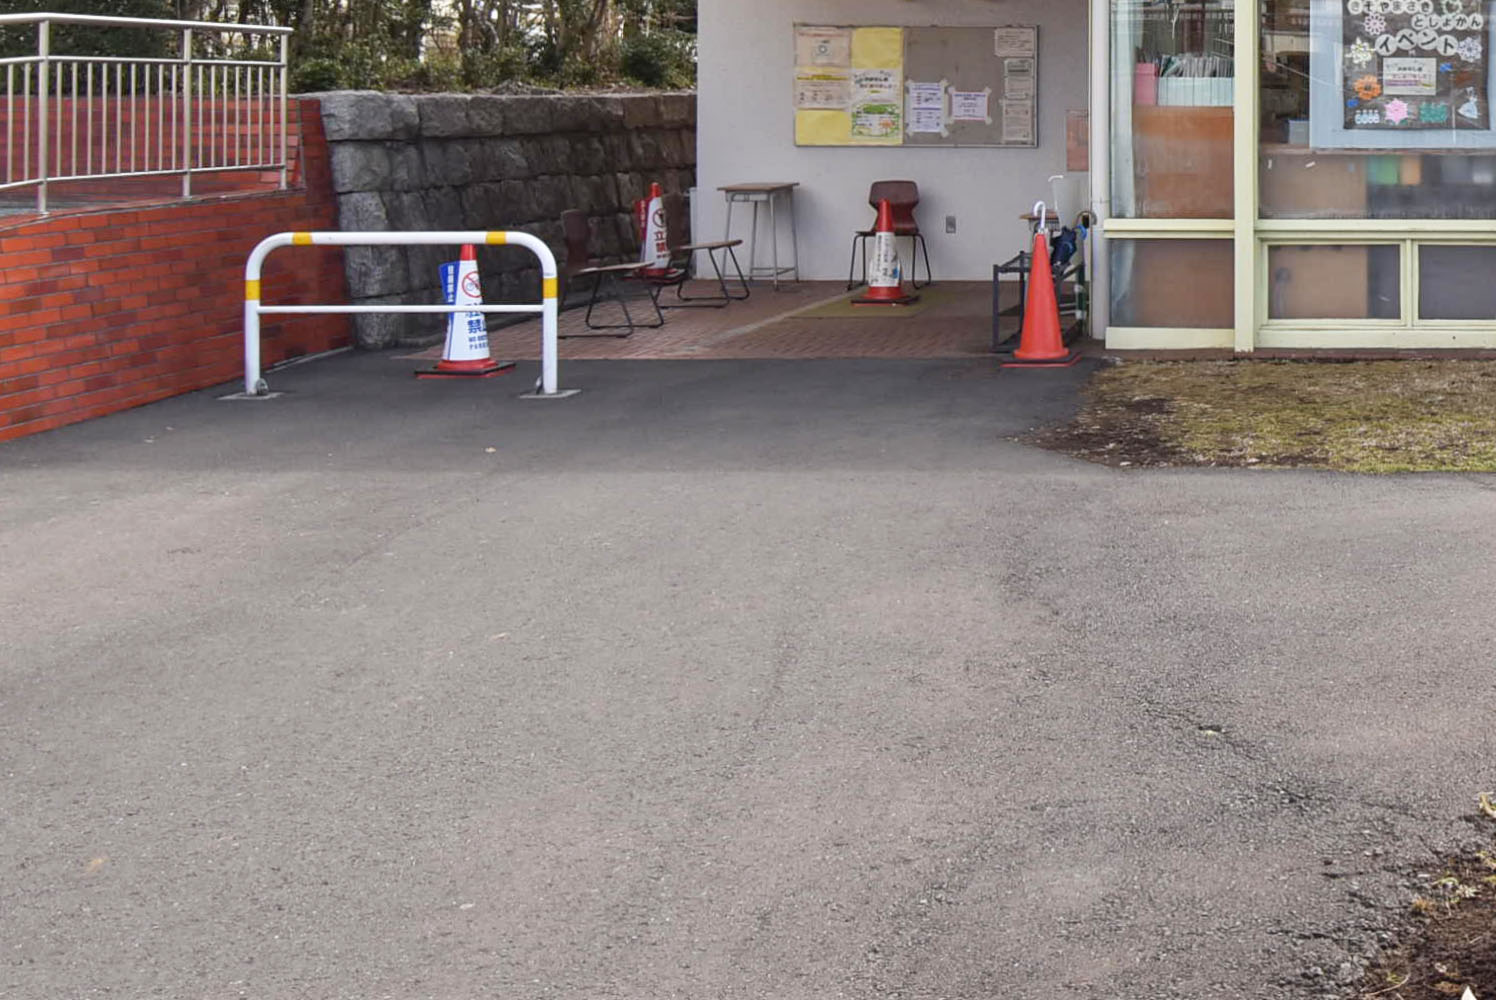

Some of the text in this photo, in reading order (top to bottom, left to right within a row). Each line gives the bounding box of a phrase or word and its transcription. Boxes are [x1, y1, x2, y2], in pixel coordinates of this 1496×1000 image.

[1413, 16, 1482, 28] としょかん
